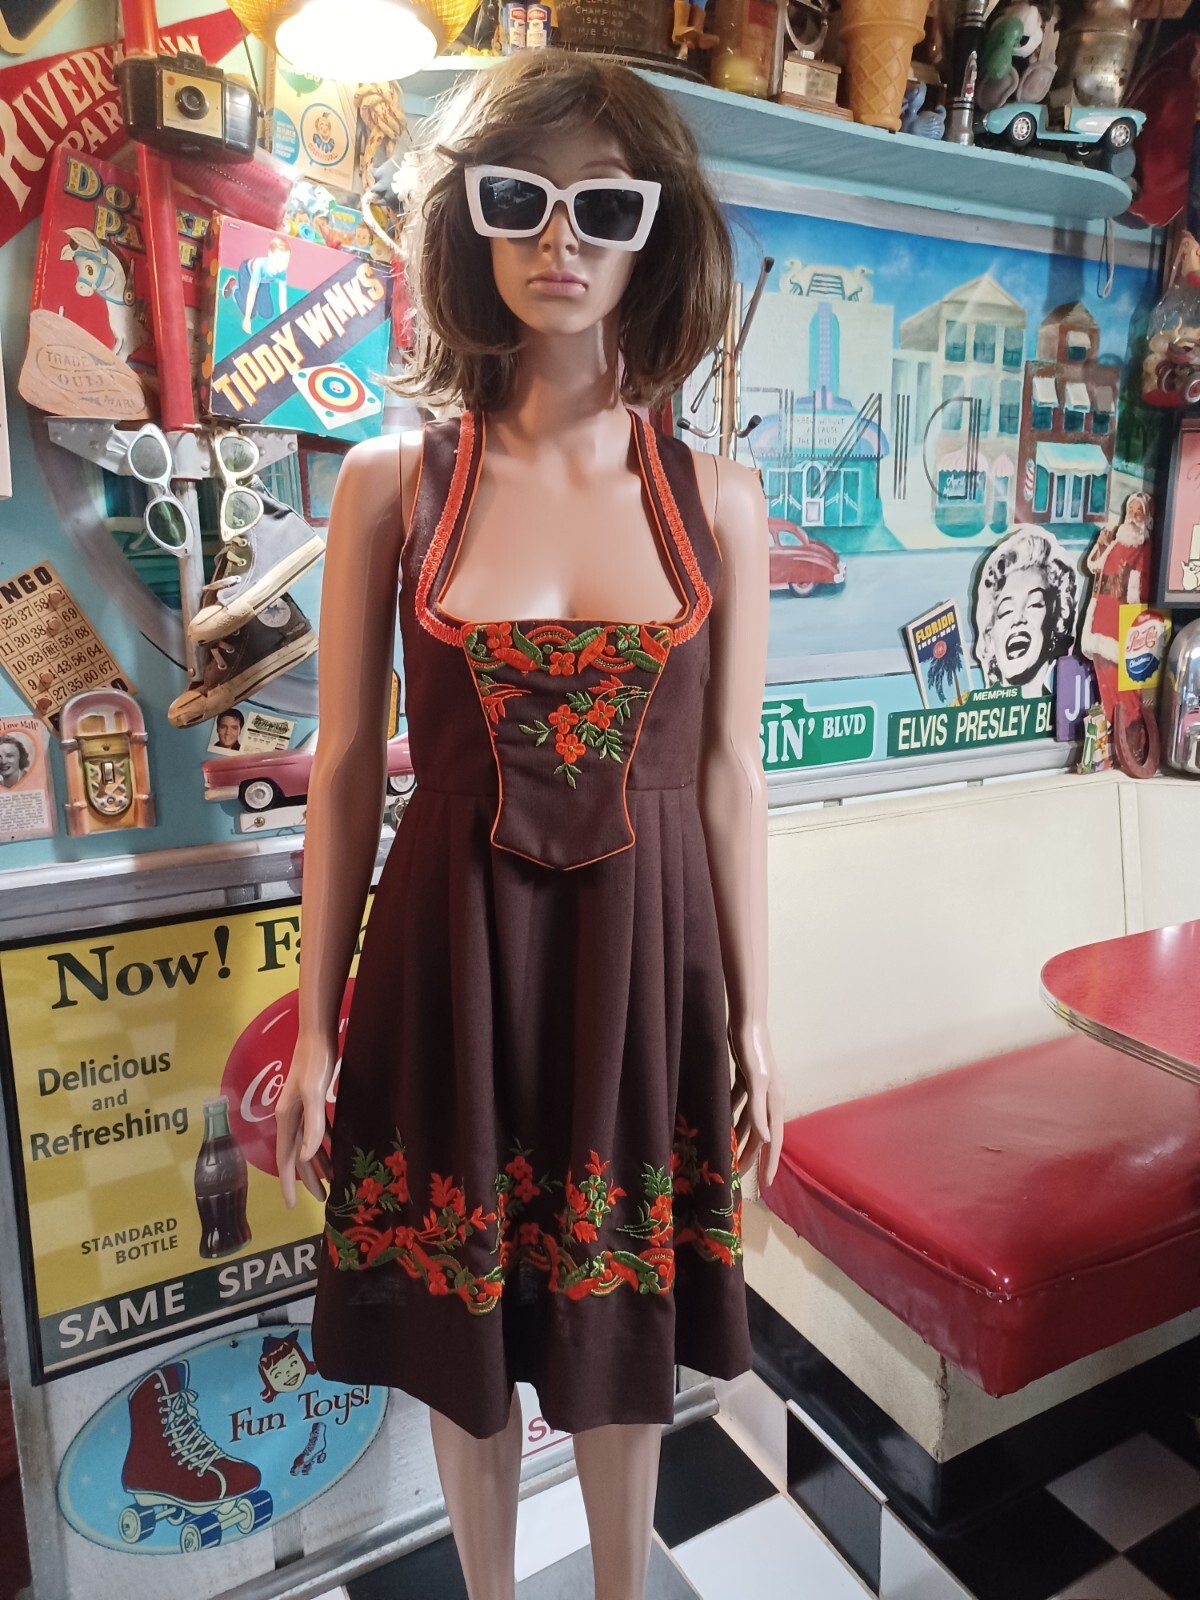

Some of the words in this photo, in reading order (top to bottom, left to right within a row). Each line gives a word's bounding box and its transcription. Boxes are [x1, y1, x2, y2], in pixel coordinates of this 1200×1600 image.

[60, 96, 124, 154] PAR
[212, 321, 305, 412] TIDDLY
[294, 262, 386, 349] WINKS
[45, 350, 90, 368] TRADE
[0, 565, 53, 610] NGO
[1, 614, 18, 630] 25
[17, 605, 34, 621] 37
[33, 597, 50, 612] 58
[13, 632, 31, 649] 30
[30, 624, 47, 640] 38
[61, 607, 78, 623] 69
[915, 611, 955, 644] FLORIDA
[12, 660, 28, 676] 10
[27, 651, 44, 667] 23
[41, 642, 60, 659] FREE
[58, 634, 75, 649] 55
[74, 625, 91, 640] 68
[27, 678, 38, 691] 9
[57, 660, 73, 676] 43
[70, 652, 87, 667] 56
[85, 642, 104, 659] 64
[53, 685, 68, 701] 27
[67, 677, 84, 693] 35
[83, 668, 99, 684] 60
[98, 660, 114, 675] 67
[973, 687, 1018, 701] MEMPHIS
[822, 713, 867, 740] BLVD
[898, 712, 948, 751] ELVIS
[954, 702, 1030, 744] PRESLEY
[38, 1050, 172, 1098] Delicious
[91, 1089, 129, 1112] and
[29, 1105, 190, 1162] Refreshing
[81, 1217, 179, 1256] STANDARD
[115, 1233, 179, 1266] BOTTLE
[58, 1281, 186, 1350] SAME
[218, 1238, 324, 1299] SPAR
[228, 1405, 288, 1444] Fun
[298, 1384, 371, 1426] Toys!
